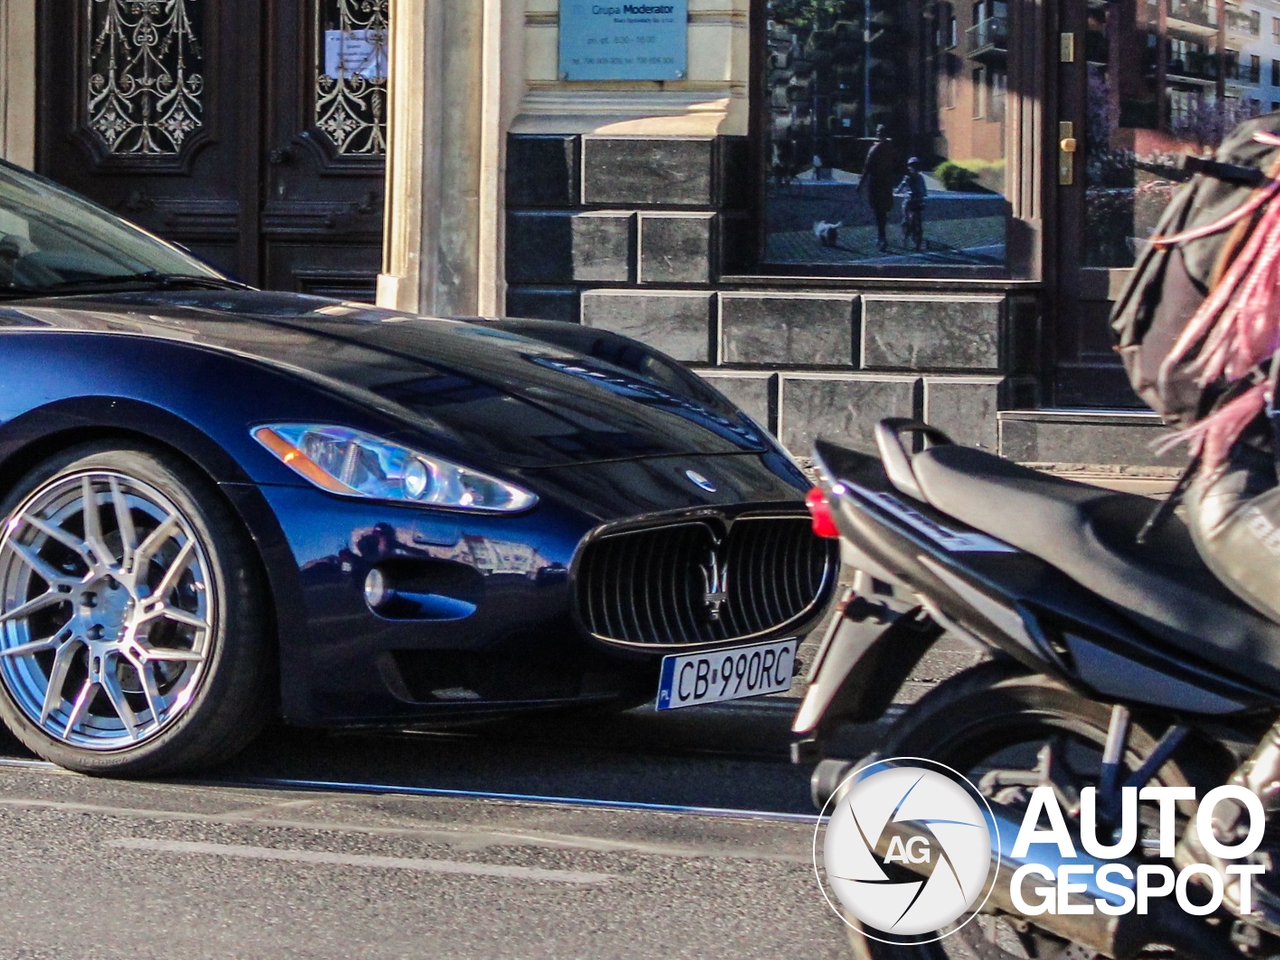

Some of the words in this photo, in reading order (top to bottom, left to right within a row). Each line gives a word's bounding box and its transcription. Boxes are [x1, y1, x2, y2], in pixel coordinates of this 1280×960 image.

[592, 5, 620, 15] Grupa
[623, 4, 674, 14] Moderator
[678, 659, 710, 701] CB
[719, 647, 790, 697] 990RC
[659, 690, 670, 700] PL
